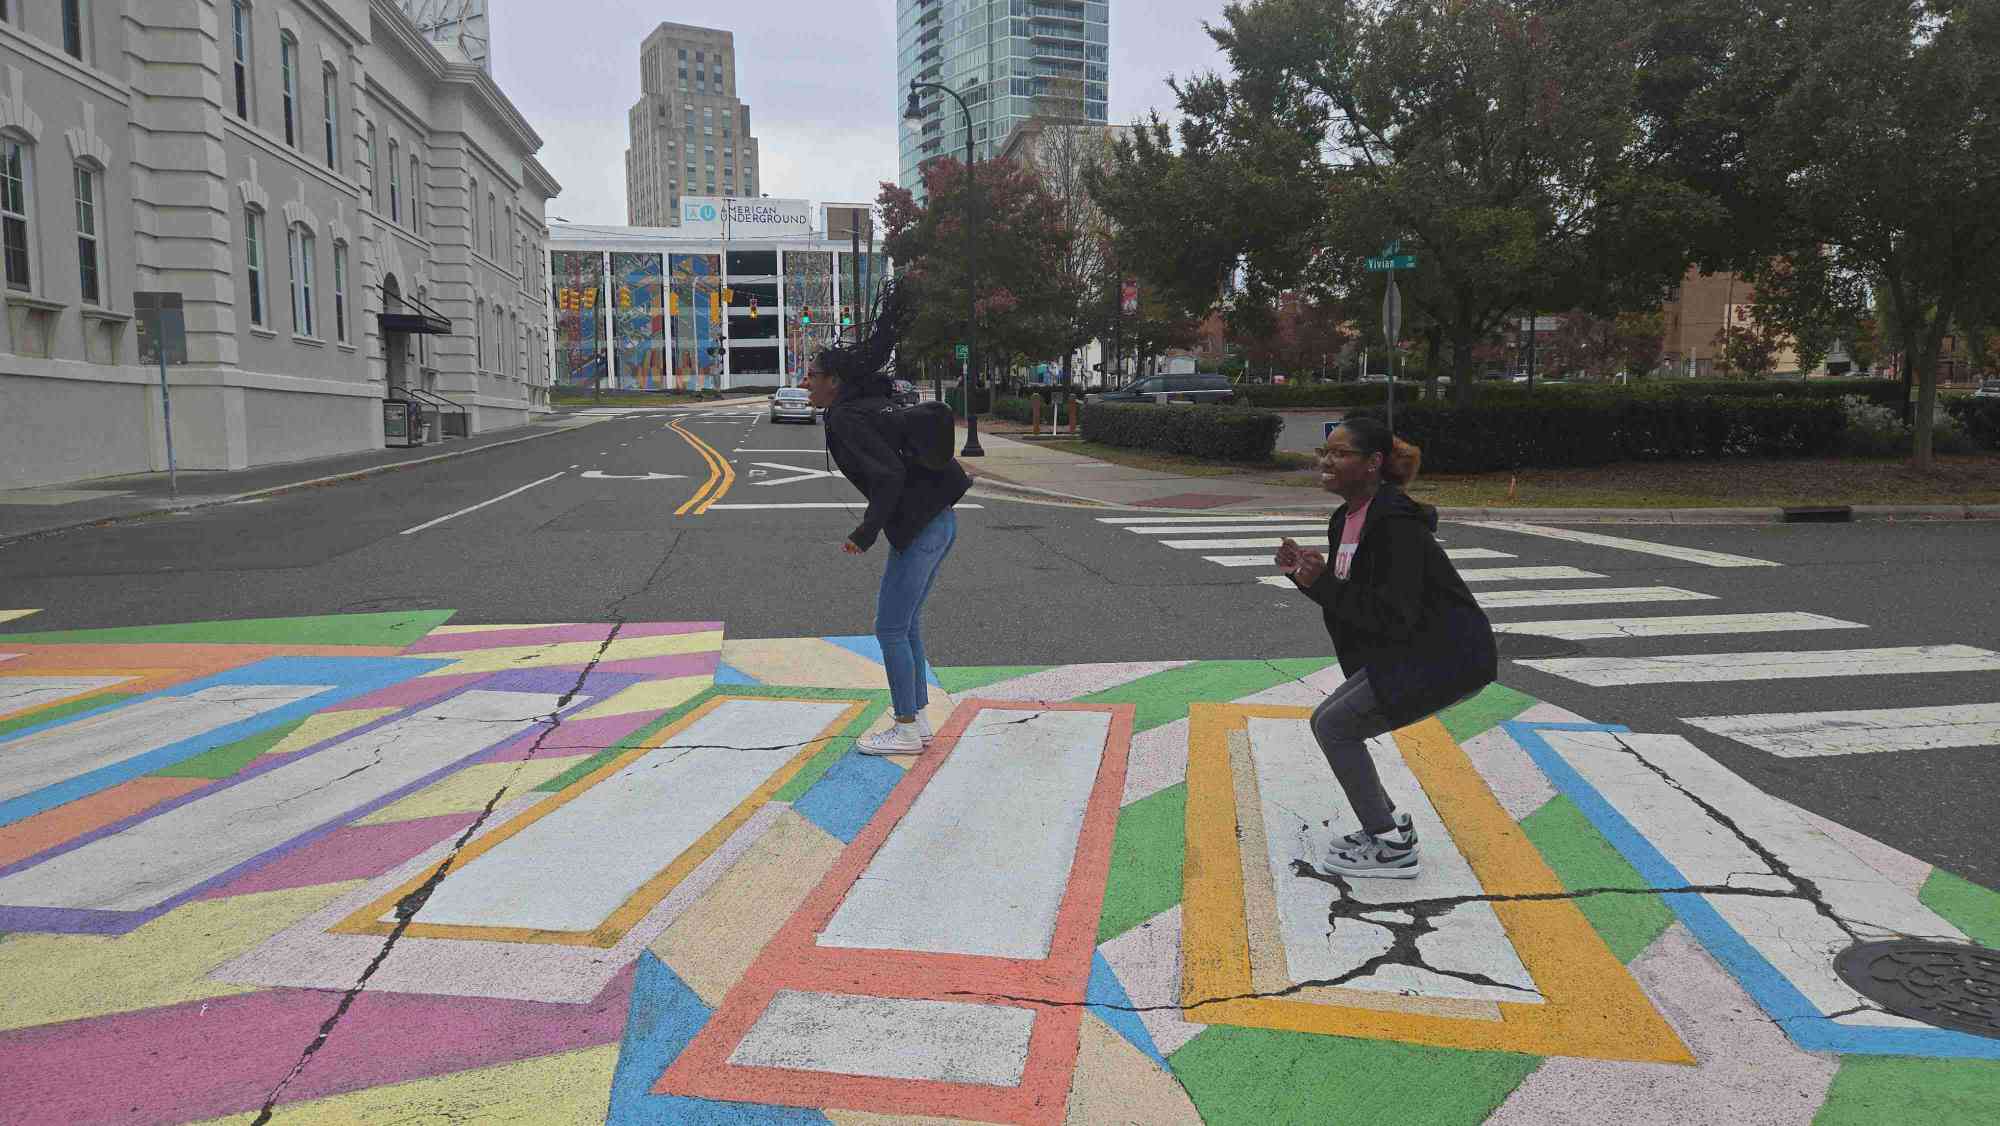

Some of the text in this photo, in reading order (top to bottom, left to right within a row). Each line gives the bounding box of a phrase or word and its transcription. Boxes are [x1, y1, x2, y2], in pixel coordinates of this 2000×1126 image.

[721, 206, 777, 215] AMERICAN
[721, 213, 807, 224] UNDERGROUND
[1368, 258, 1393, 269] Vivian
